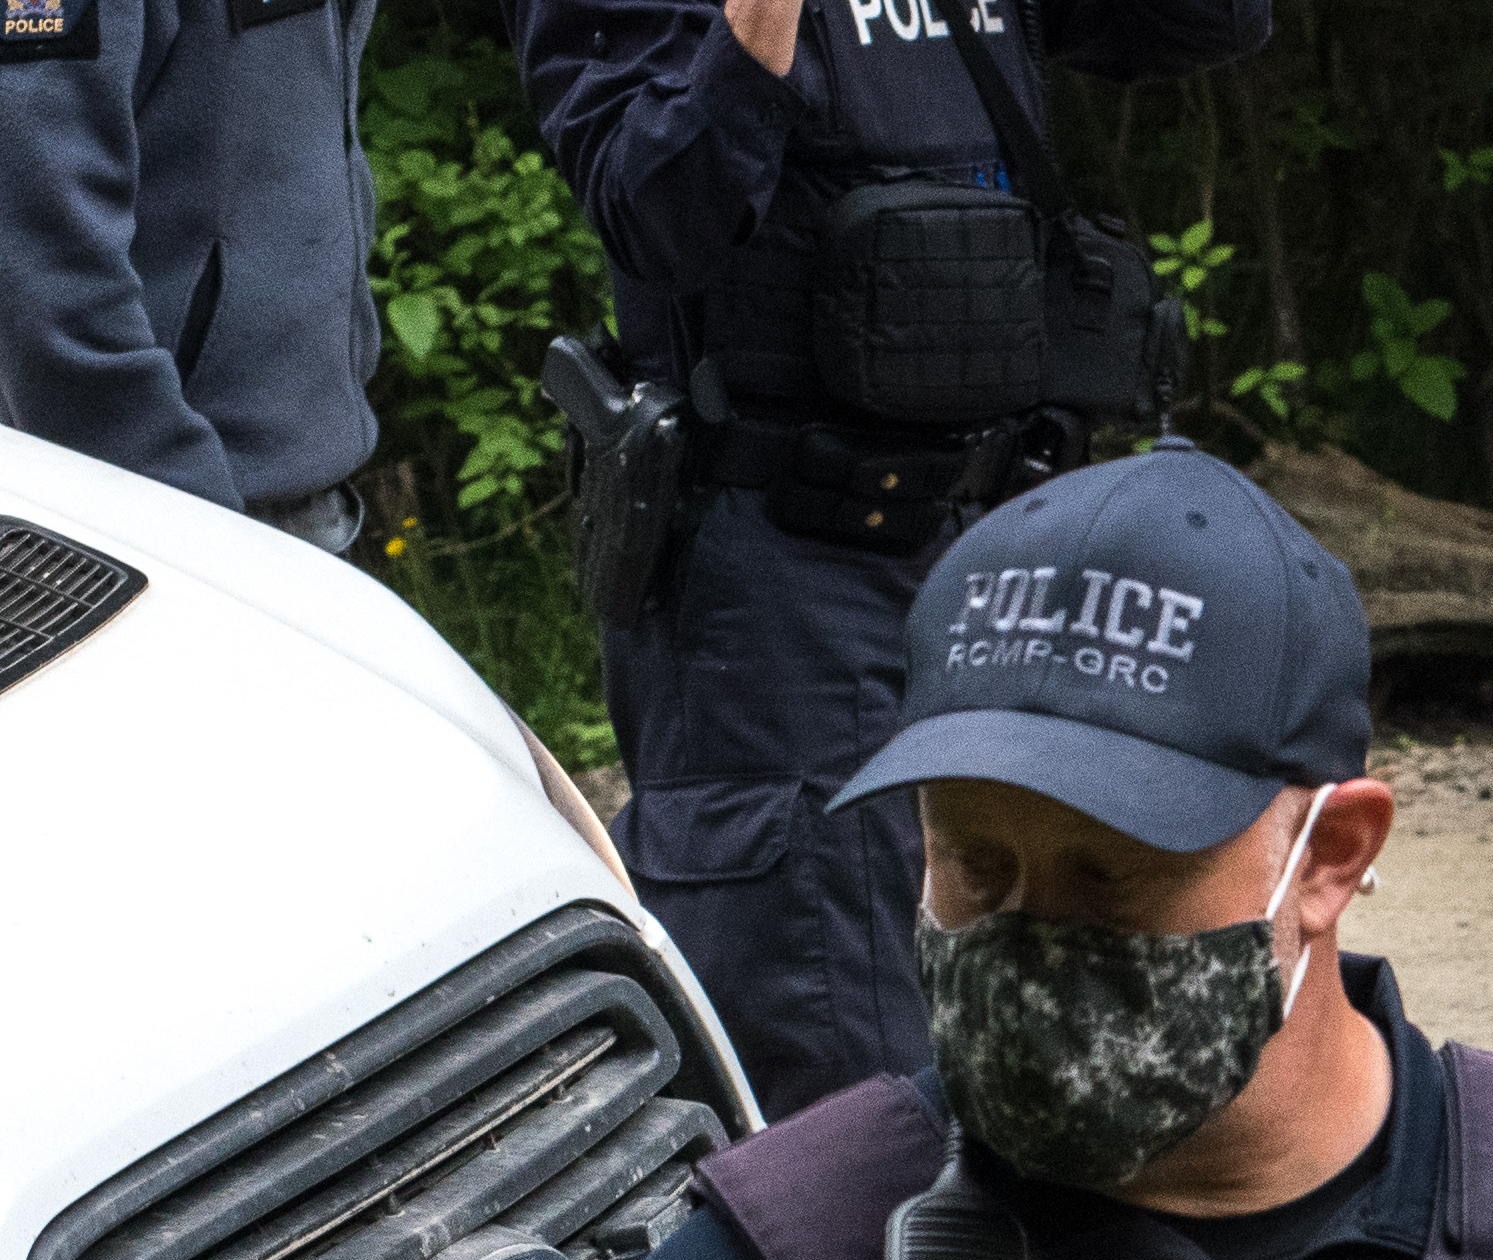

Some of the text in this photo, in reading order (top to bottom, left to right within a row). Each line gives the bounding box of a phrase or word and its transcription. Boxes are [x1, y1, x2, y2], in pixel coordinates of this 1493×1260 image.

[4, 18, 64, 35] POLICE
[949, 566, 1205, 663] POLICE
[945, 638, 1169, 694] RCMP-GRC
